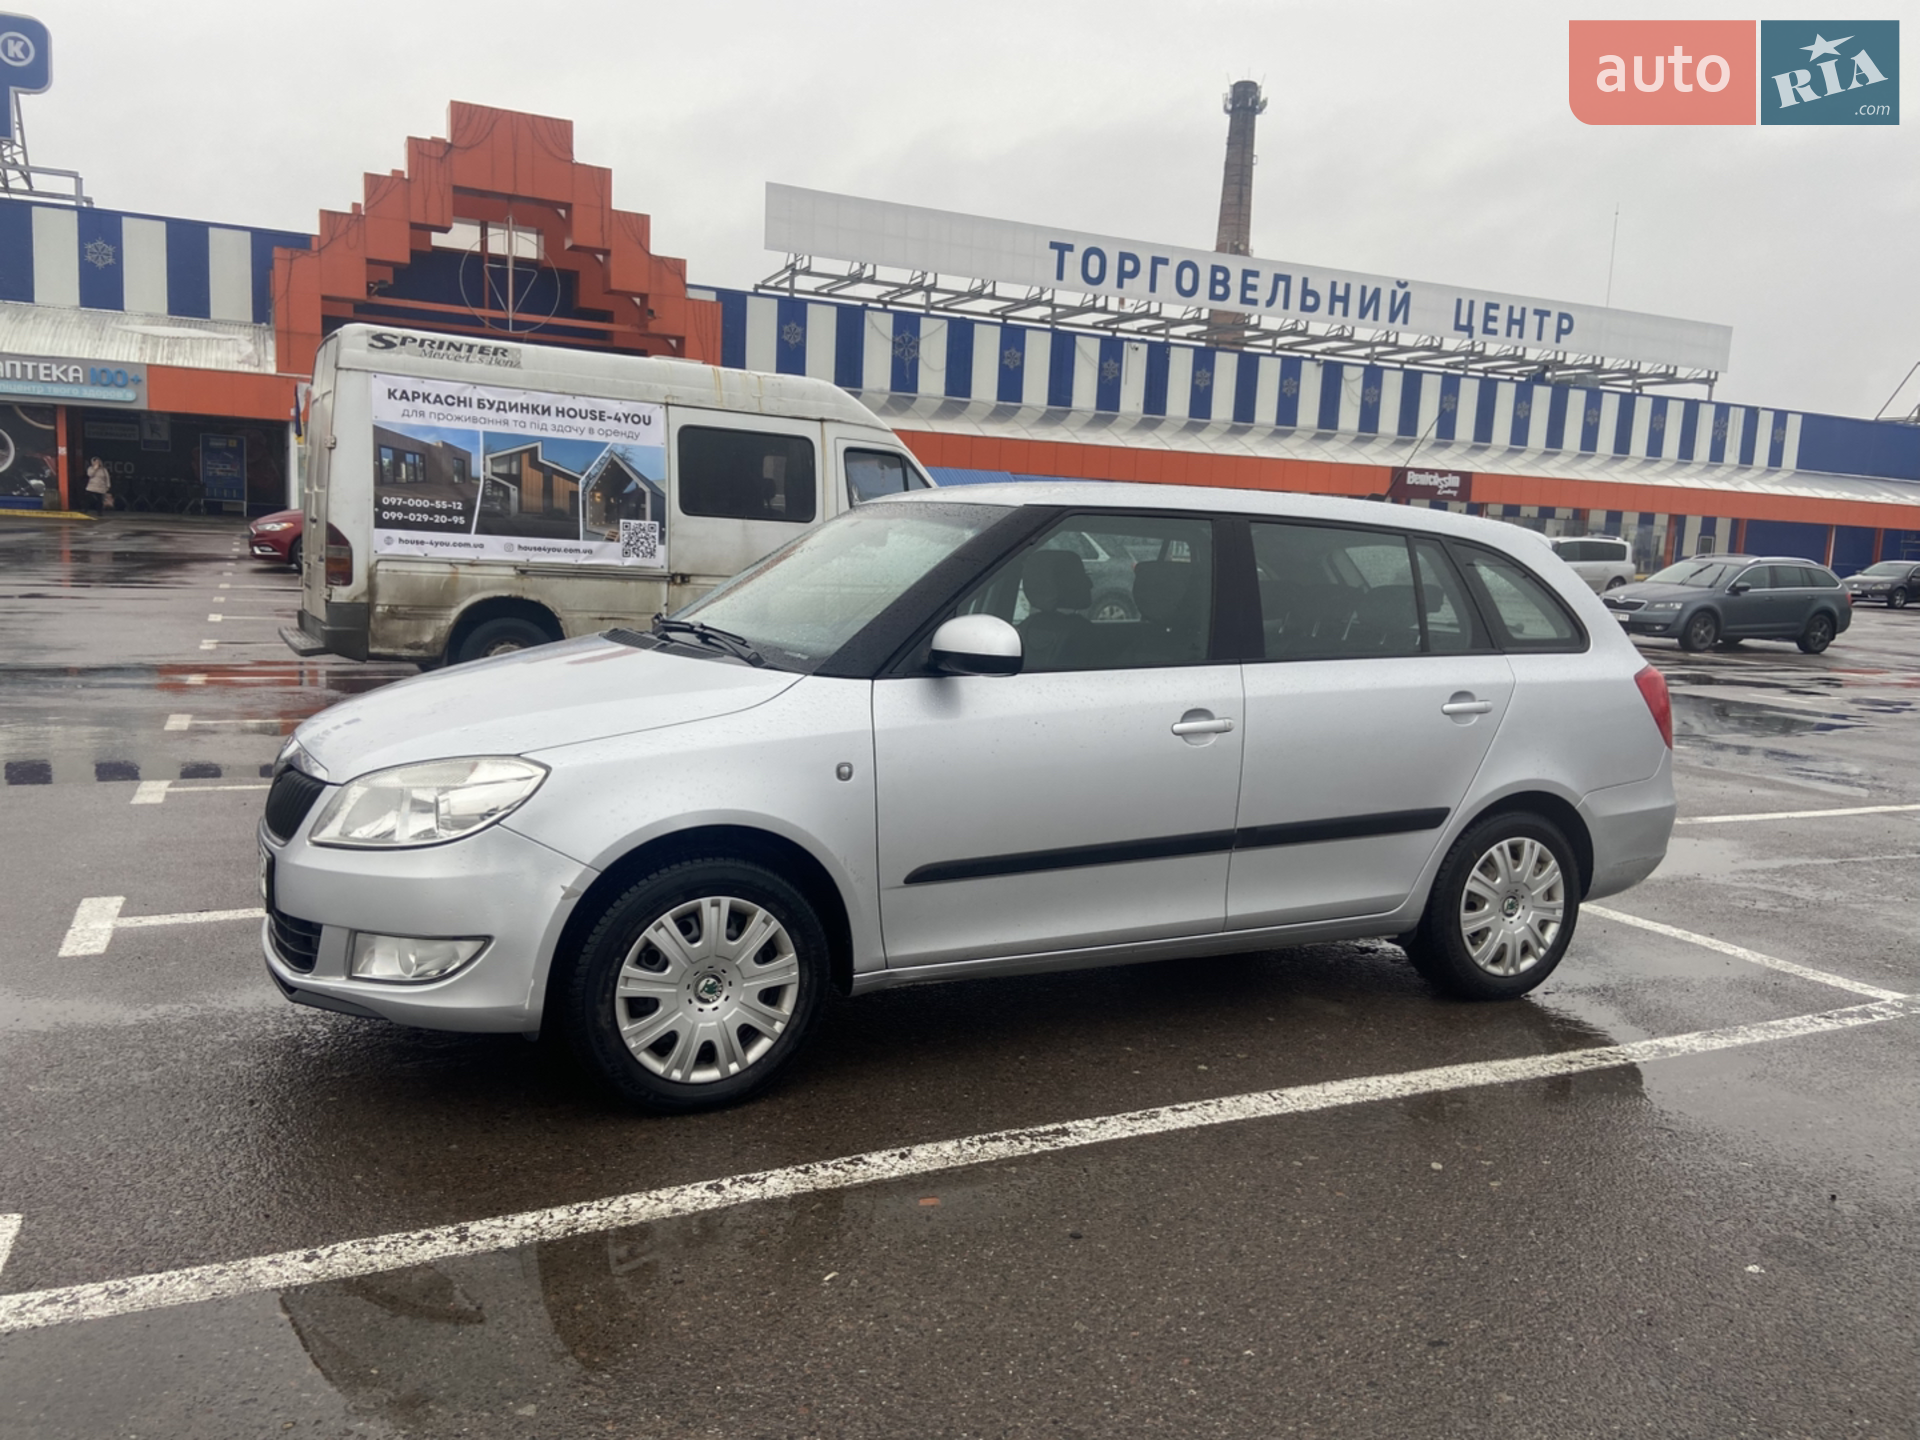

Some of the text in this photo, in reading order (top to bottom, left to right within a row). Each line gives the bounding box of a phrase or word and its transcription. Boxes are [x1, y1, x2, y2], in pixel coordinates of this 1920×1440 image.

[1049, 241, 1575, 344] ТОРГОВЕЛЬНИЙ ЦЕНТР
[368, 333, 509, 358] SPRINTER
[0, 360, 84, 383] ПТЕКА
[387, 388, 652, 426] КАРКАСНІ БУДИНКИ HOUSE-4YOU
[401, 409, 640, 440] для проживання та під здачу в оренду
[382, 496, 463, 510] 097-000-55-12
[382, 511, 465, 524] 099-029-20-95
[398, 537, 485, 549] house-4you.com.ua
[517, 544, 594, 555] house4you.com.ua
